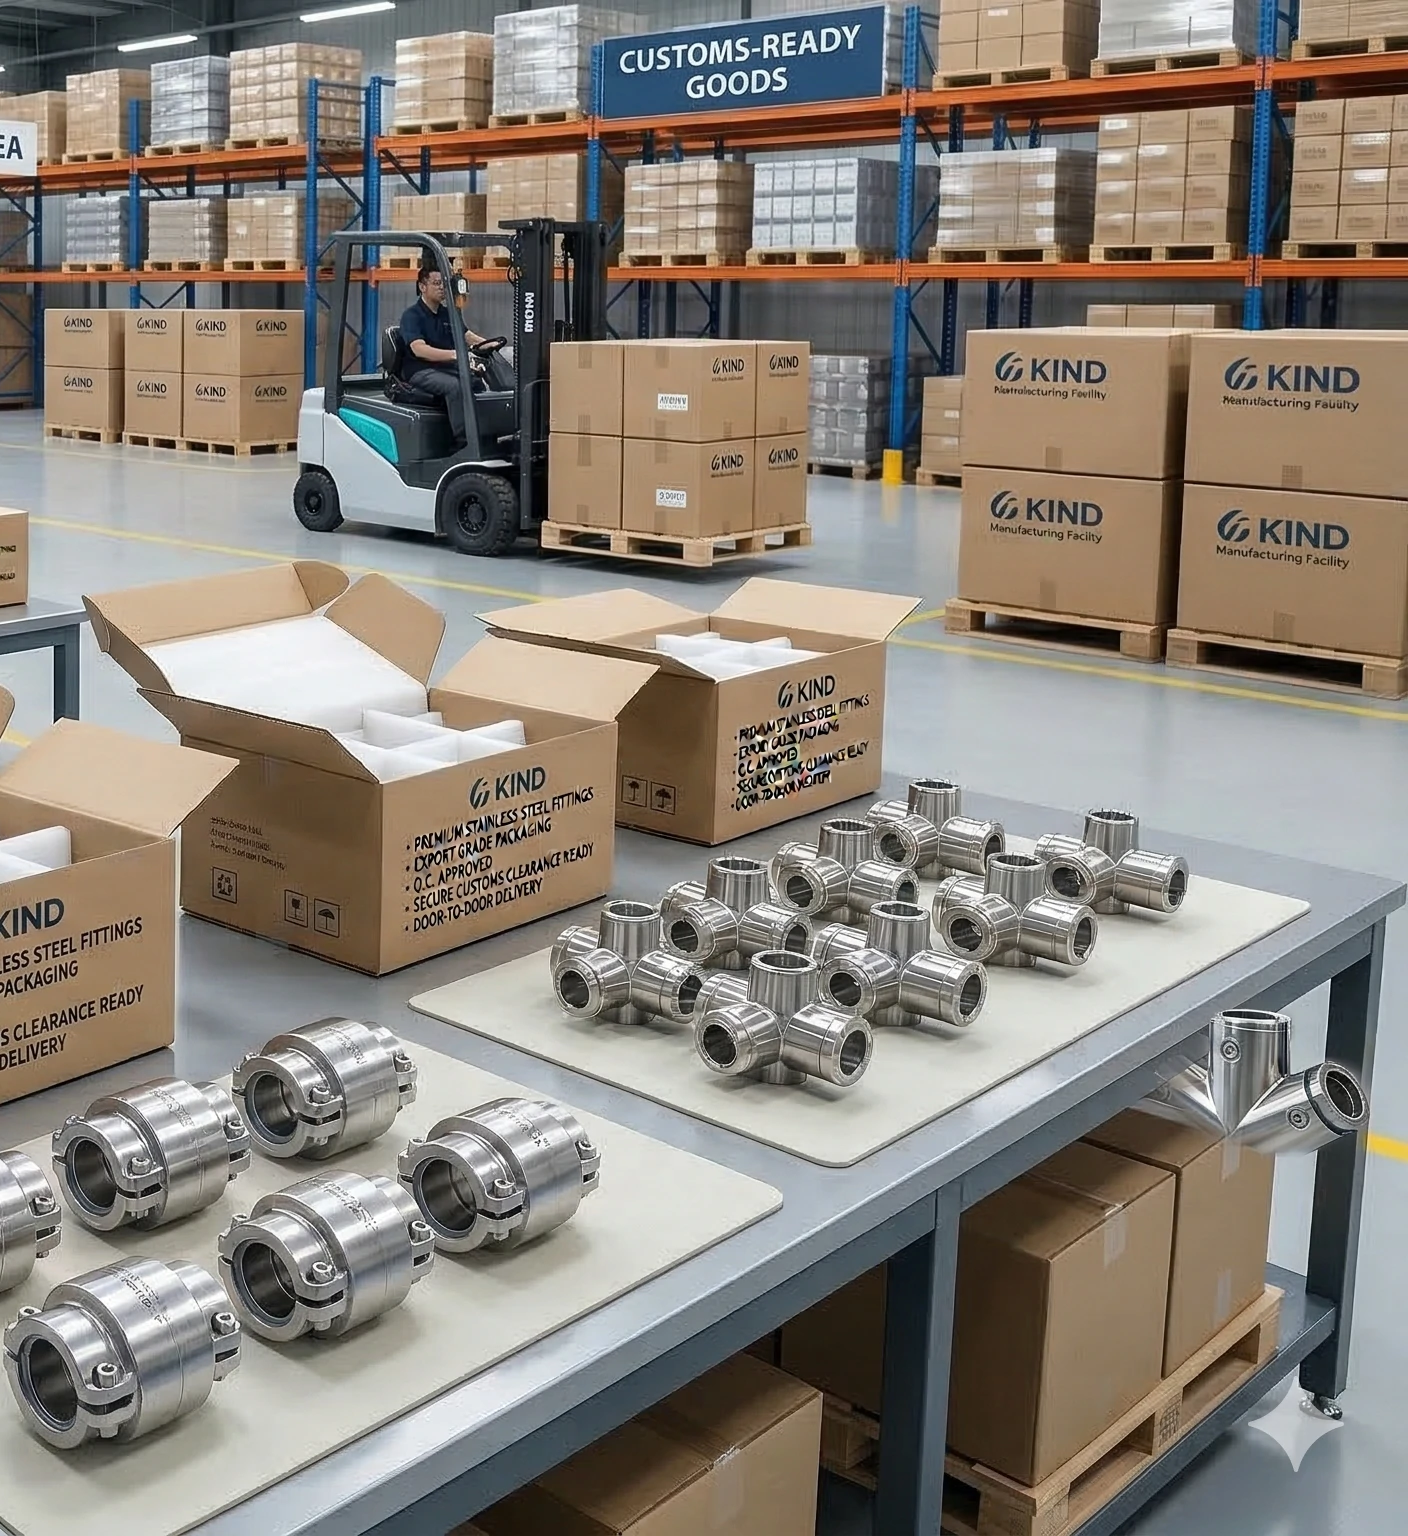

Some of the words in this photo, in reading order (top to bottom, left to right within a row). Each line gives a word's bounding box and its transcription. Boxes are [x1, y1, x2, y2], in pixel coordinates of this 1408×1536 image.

[619, 24, 862, 74] CUSTOMS-READY
[685, 67, 788, 98] GOODS
[722, 358, 745, 372] KIND
[1030, 358, 1107, 384] KIND
[1268, 364, 1360, 394] KIND
[721, 454, 744, 470] KIND
[1026, 498, 1104, 526] KIND
[990, 522, 1064, 541] Manufacturing
[1260, 518, 1350, 550] KIND
[1216, 544, 1302, 565] Manufacturing
[1306, 554, 1350, 570] Facility
[797, 674, 836, 704] KIND
[496, 766, 546, 800] KIND
[458, 835, 492, 859] GRADE
[414, 874, 435, 894] Q.C.
[414, 886, 454, 913] SECURE
[414, 893, 494, 932] DOOR-TO-DOOR
[33, 937, 77, 964] STEEL
[80, 916, 142, 950] FITTINGS
[14, 1000, 96, 1042] CLEARANCE
[100, 984, 144, 1014] READY
